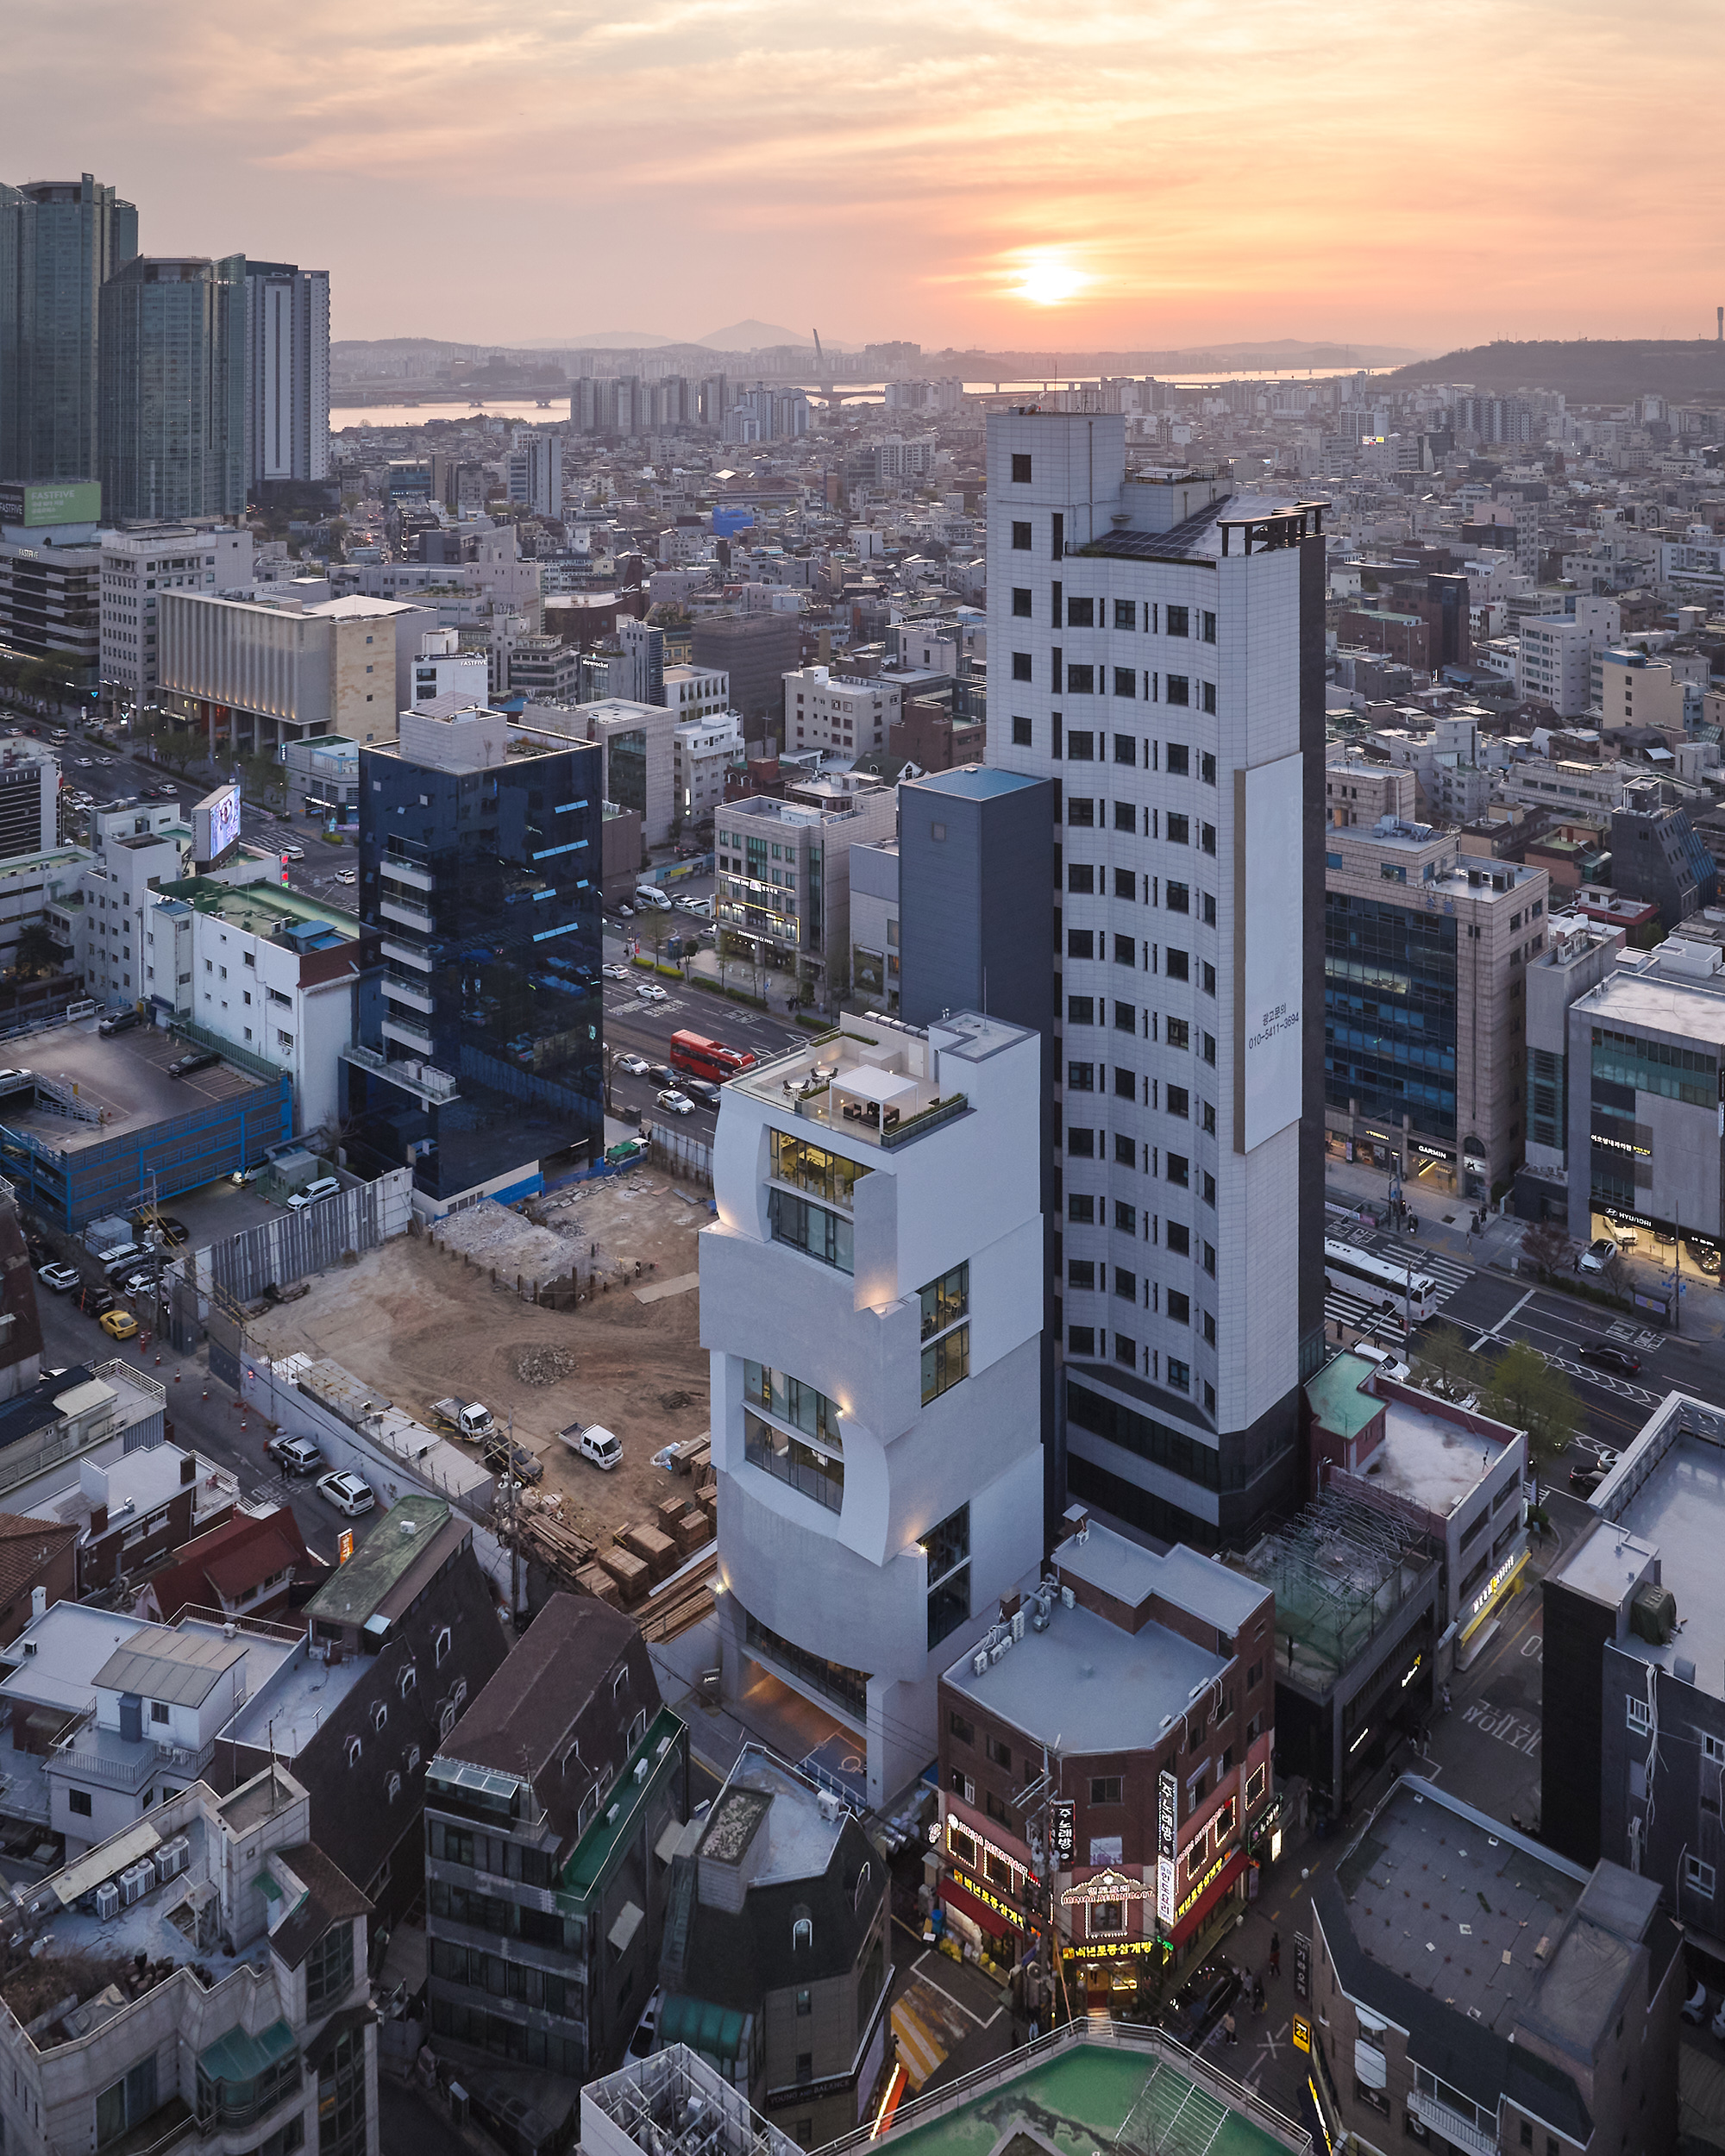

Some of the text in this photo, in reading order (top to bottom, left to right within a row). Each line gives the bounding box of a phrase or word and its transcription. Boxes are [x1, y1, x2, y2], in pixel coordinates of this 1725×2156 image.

[32, 490, 75, 500] FASTFIVE
[19, 548, 39, 559] FASTFIVE
[1263, 1003, 1286, 1026] 광고문의
[1418, 1145, 1446, 1159] GARMIN
[1619, 1212, 1652, 1227] HYUNDAI
